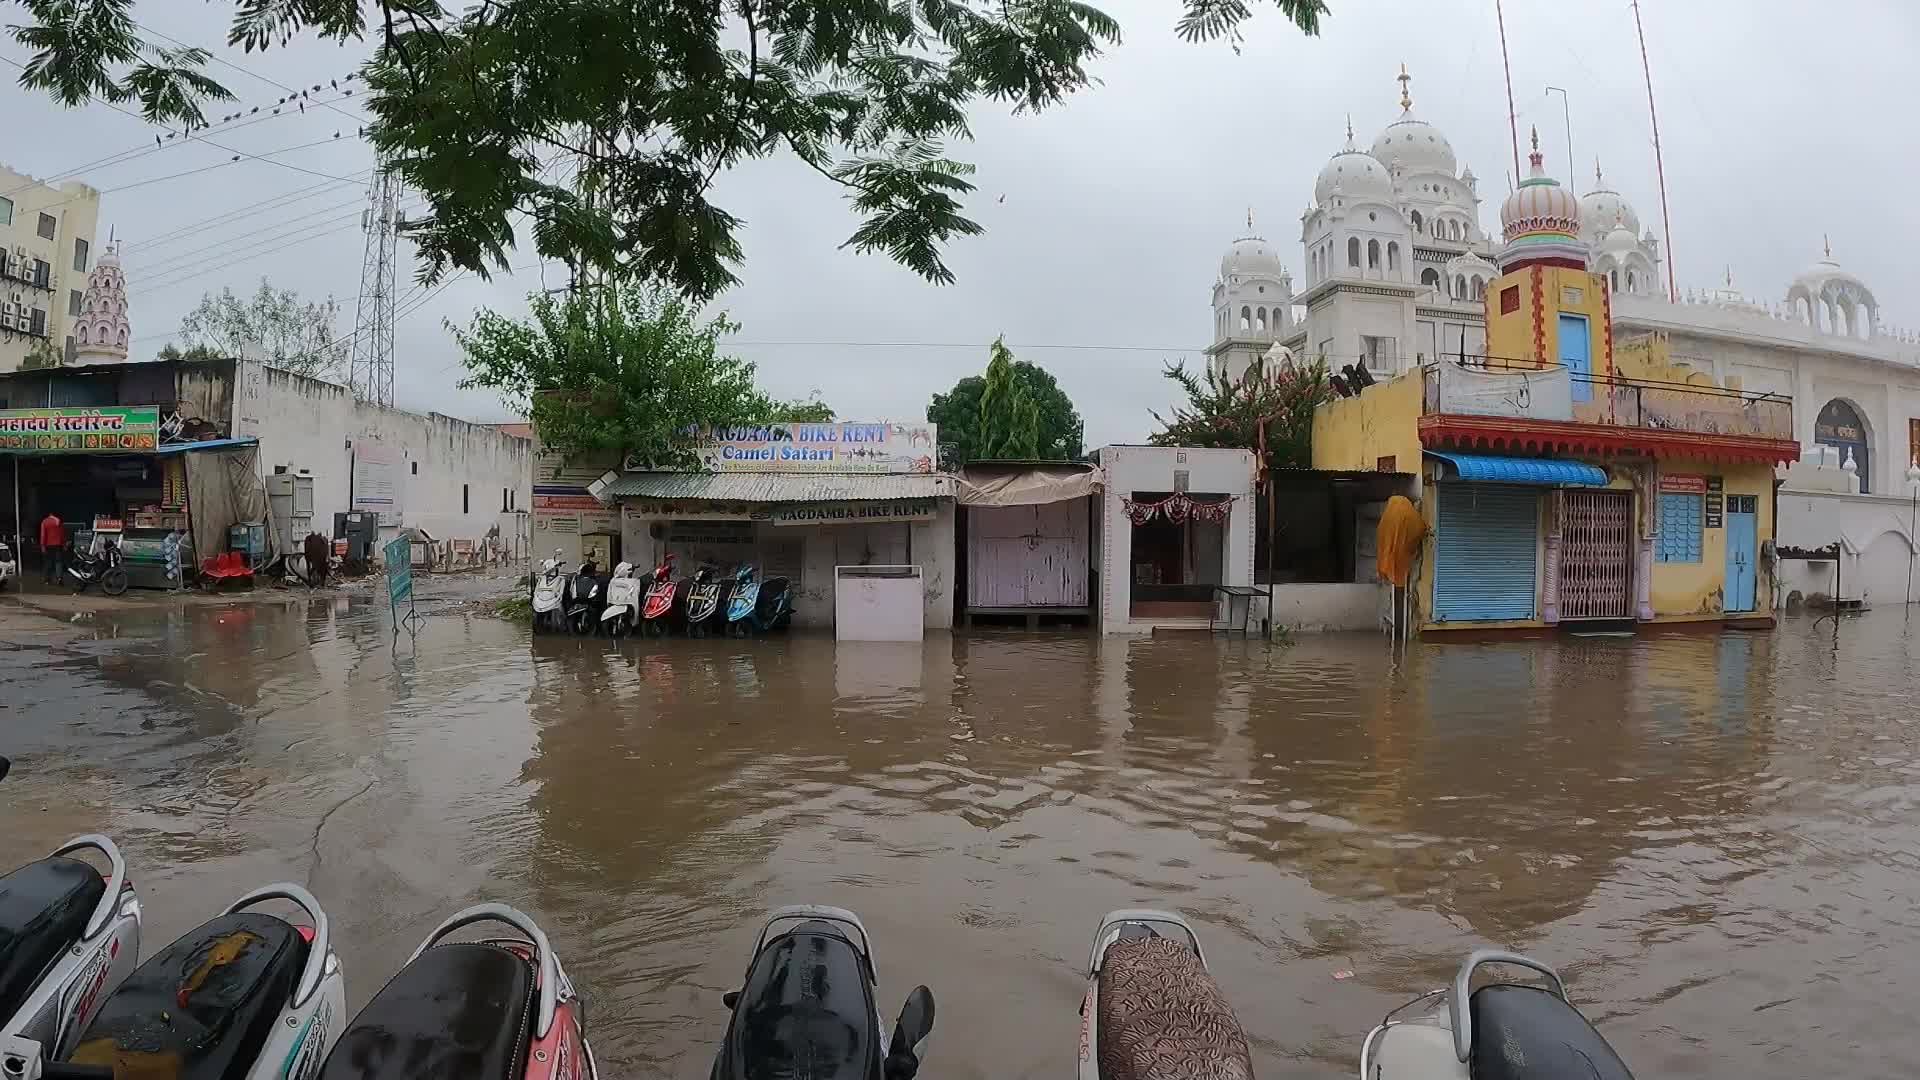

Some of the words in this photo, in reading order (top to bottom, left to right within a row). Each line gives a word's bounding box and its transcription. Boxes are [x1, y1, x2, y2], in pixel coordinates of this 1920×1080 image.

[799, 426, 838, 442] BIKE
[843, 425, 885, 442] RENT
[722, 445, 776, 460] Camel
[781, 446, 833, 460] Safari
[859, 506, 891, 517] BIKE
[895, 505, 929, 516] RENT
